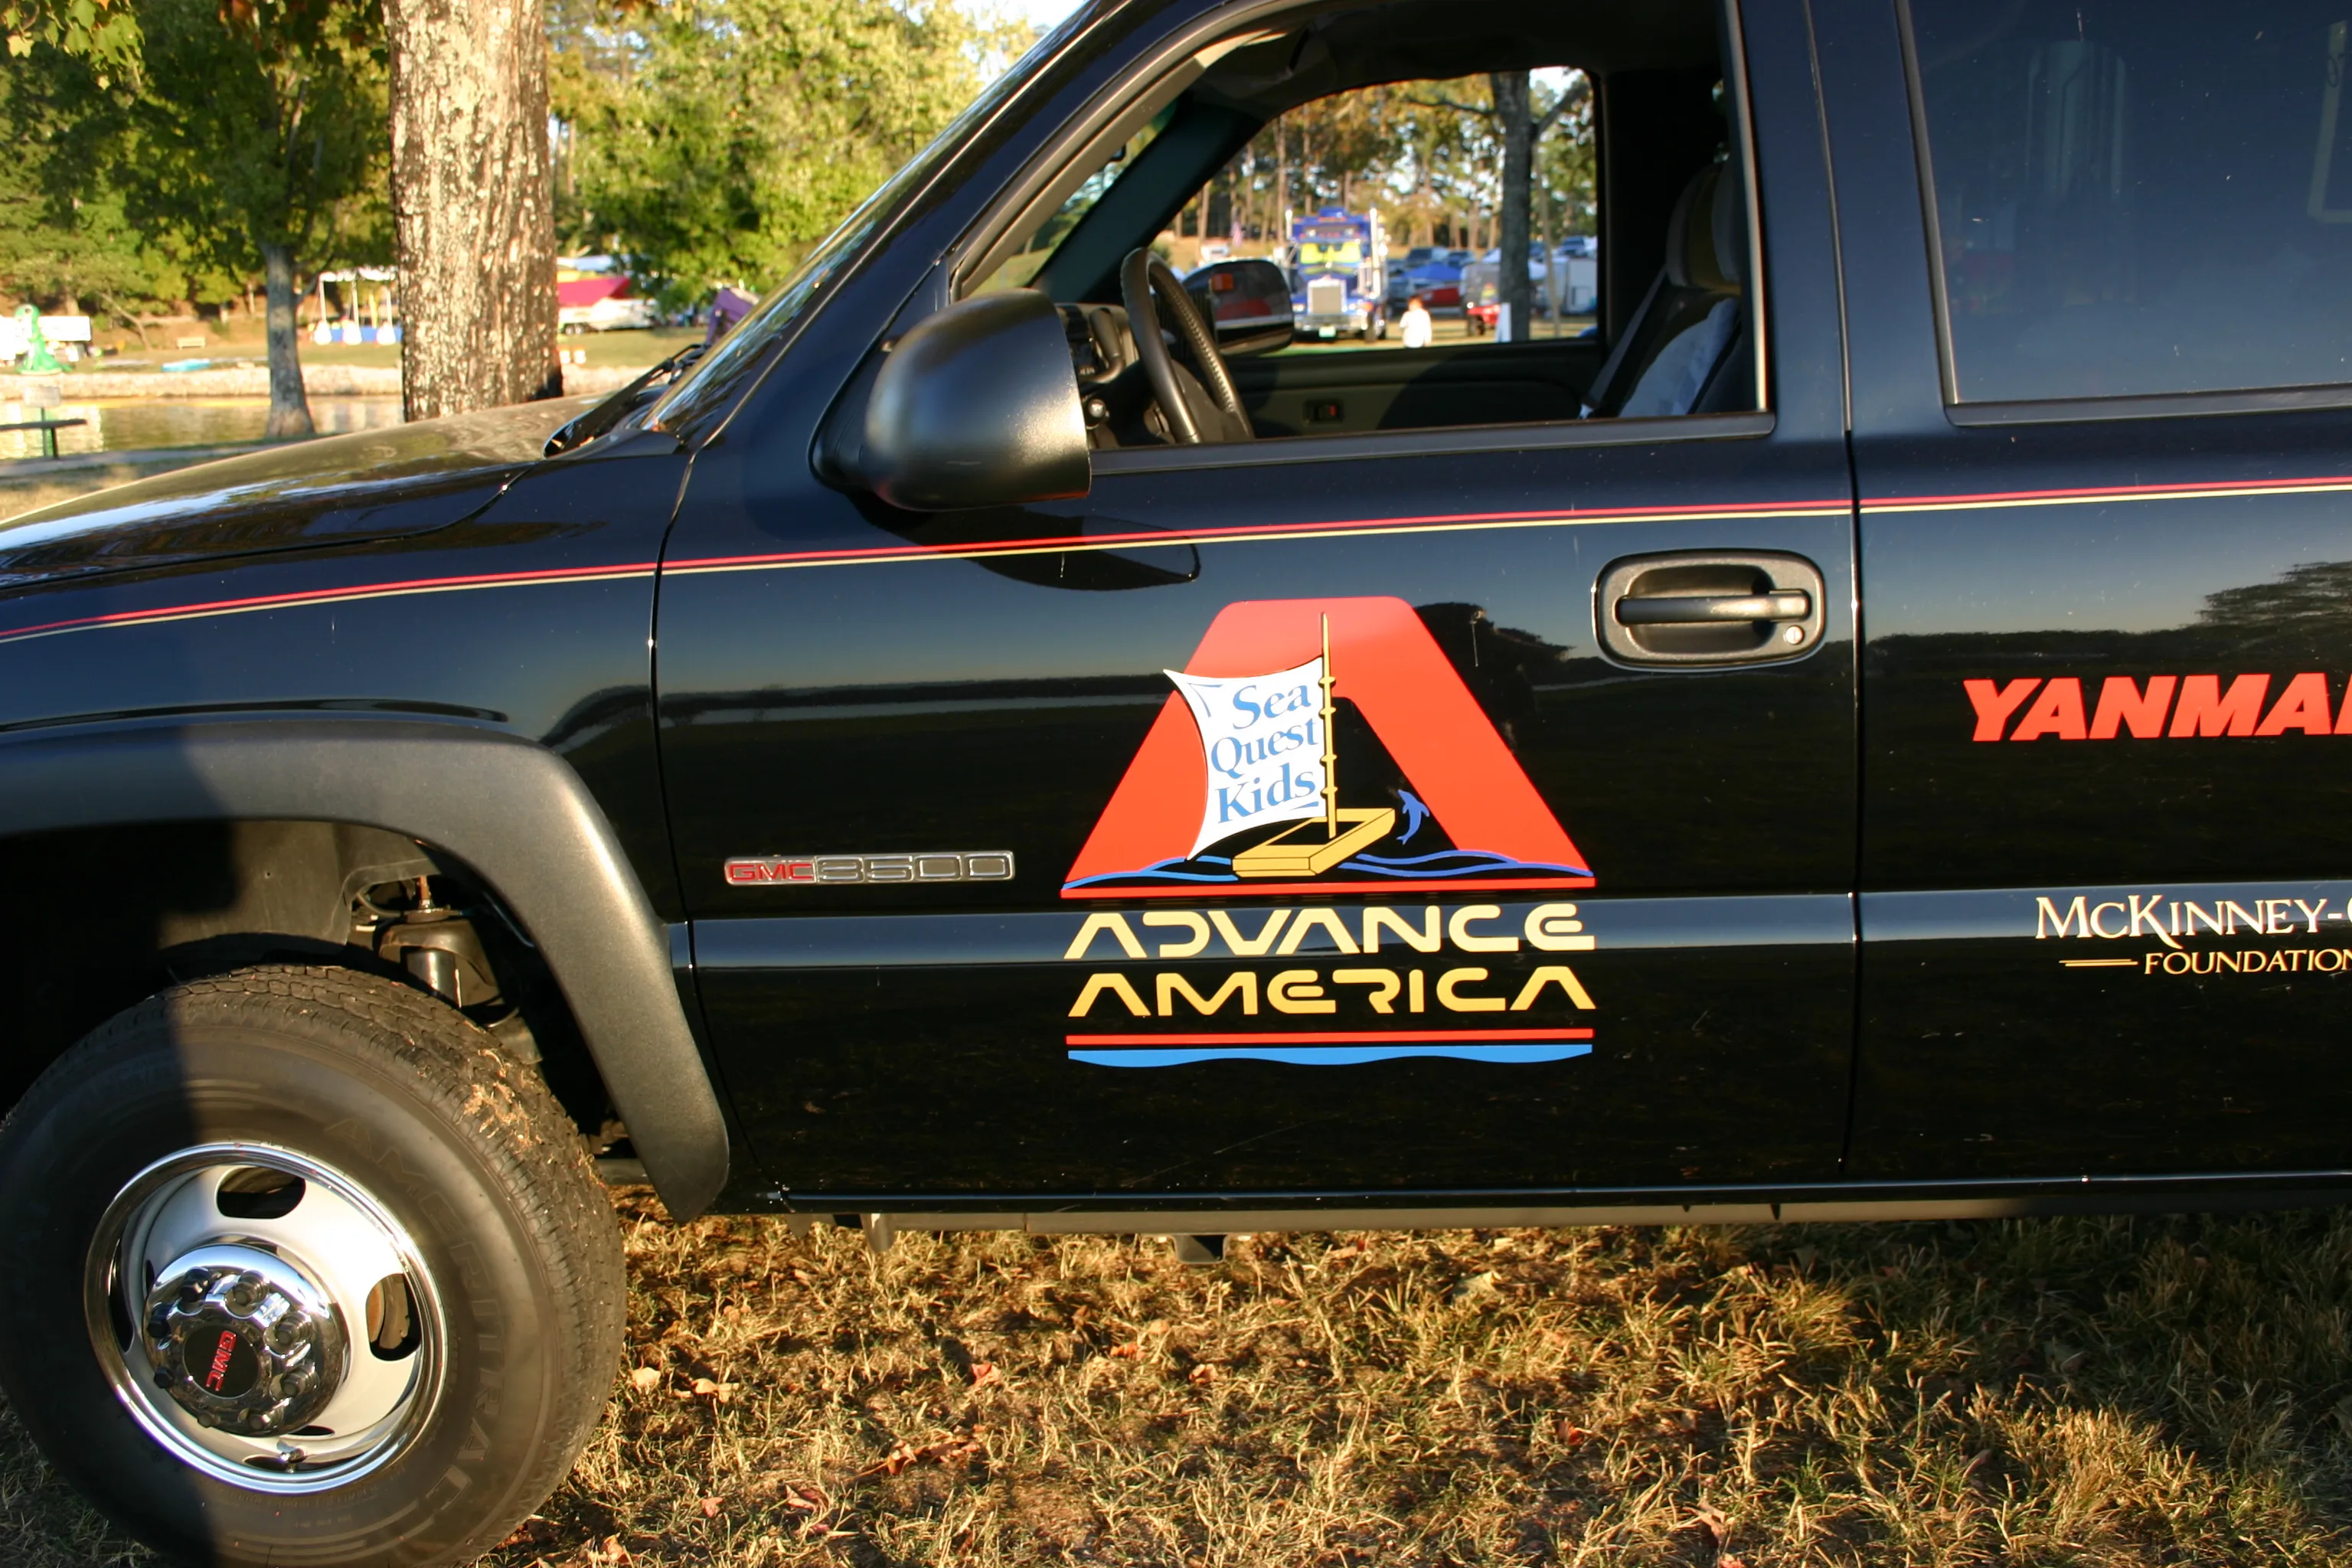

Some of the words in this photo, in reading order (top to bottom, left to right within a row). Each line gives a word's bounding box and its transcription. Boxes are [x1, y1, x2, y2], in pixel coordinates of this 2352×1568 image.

[1232, 680, 1312, 730] Sea
[1210, 715, 1319, 779] Quest
[1217, 762, 1317, 825] Kids
[728, 861, 815, 882] GMC
[815, 851, 1014, 884] 3500
[1063, 903, 1596, 960] ADVANCE
[2035, 894, 2352, 949] McKINNEY-
[1068, 965, 1596, 1018] AMERICA
[205, 1330, 237, 1392] GMC
